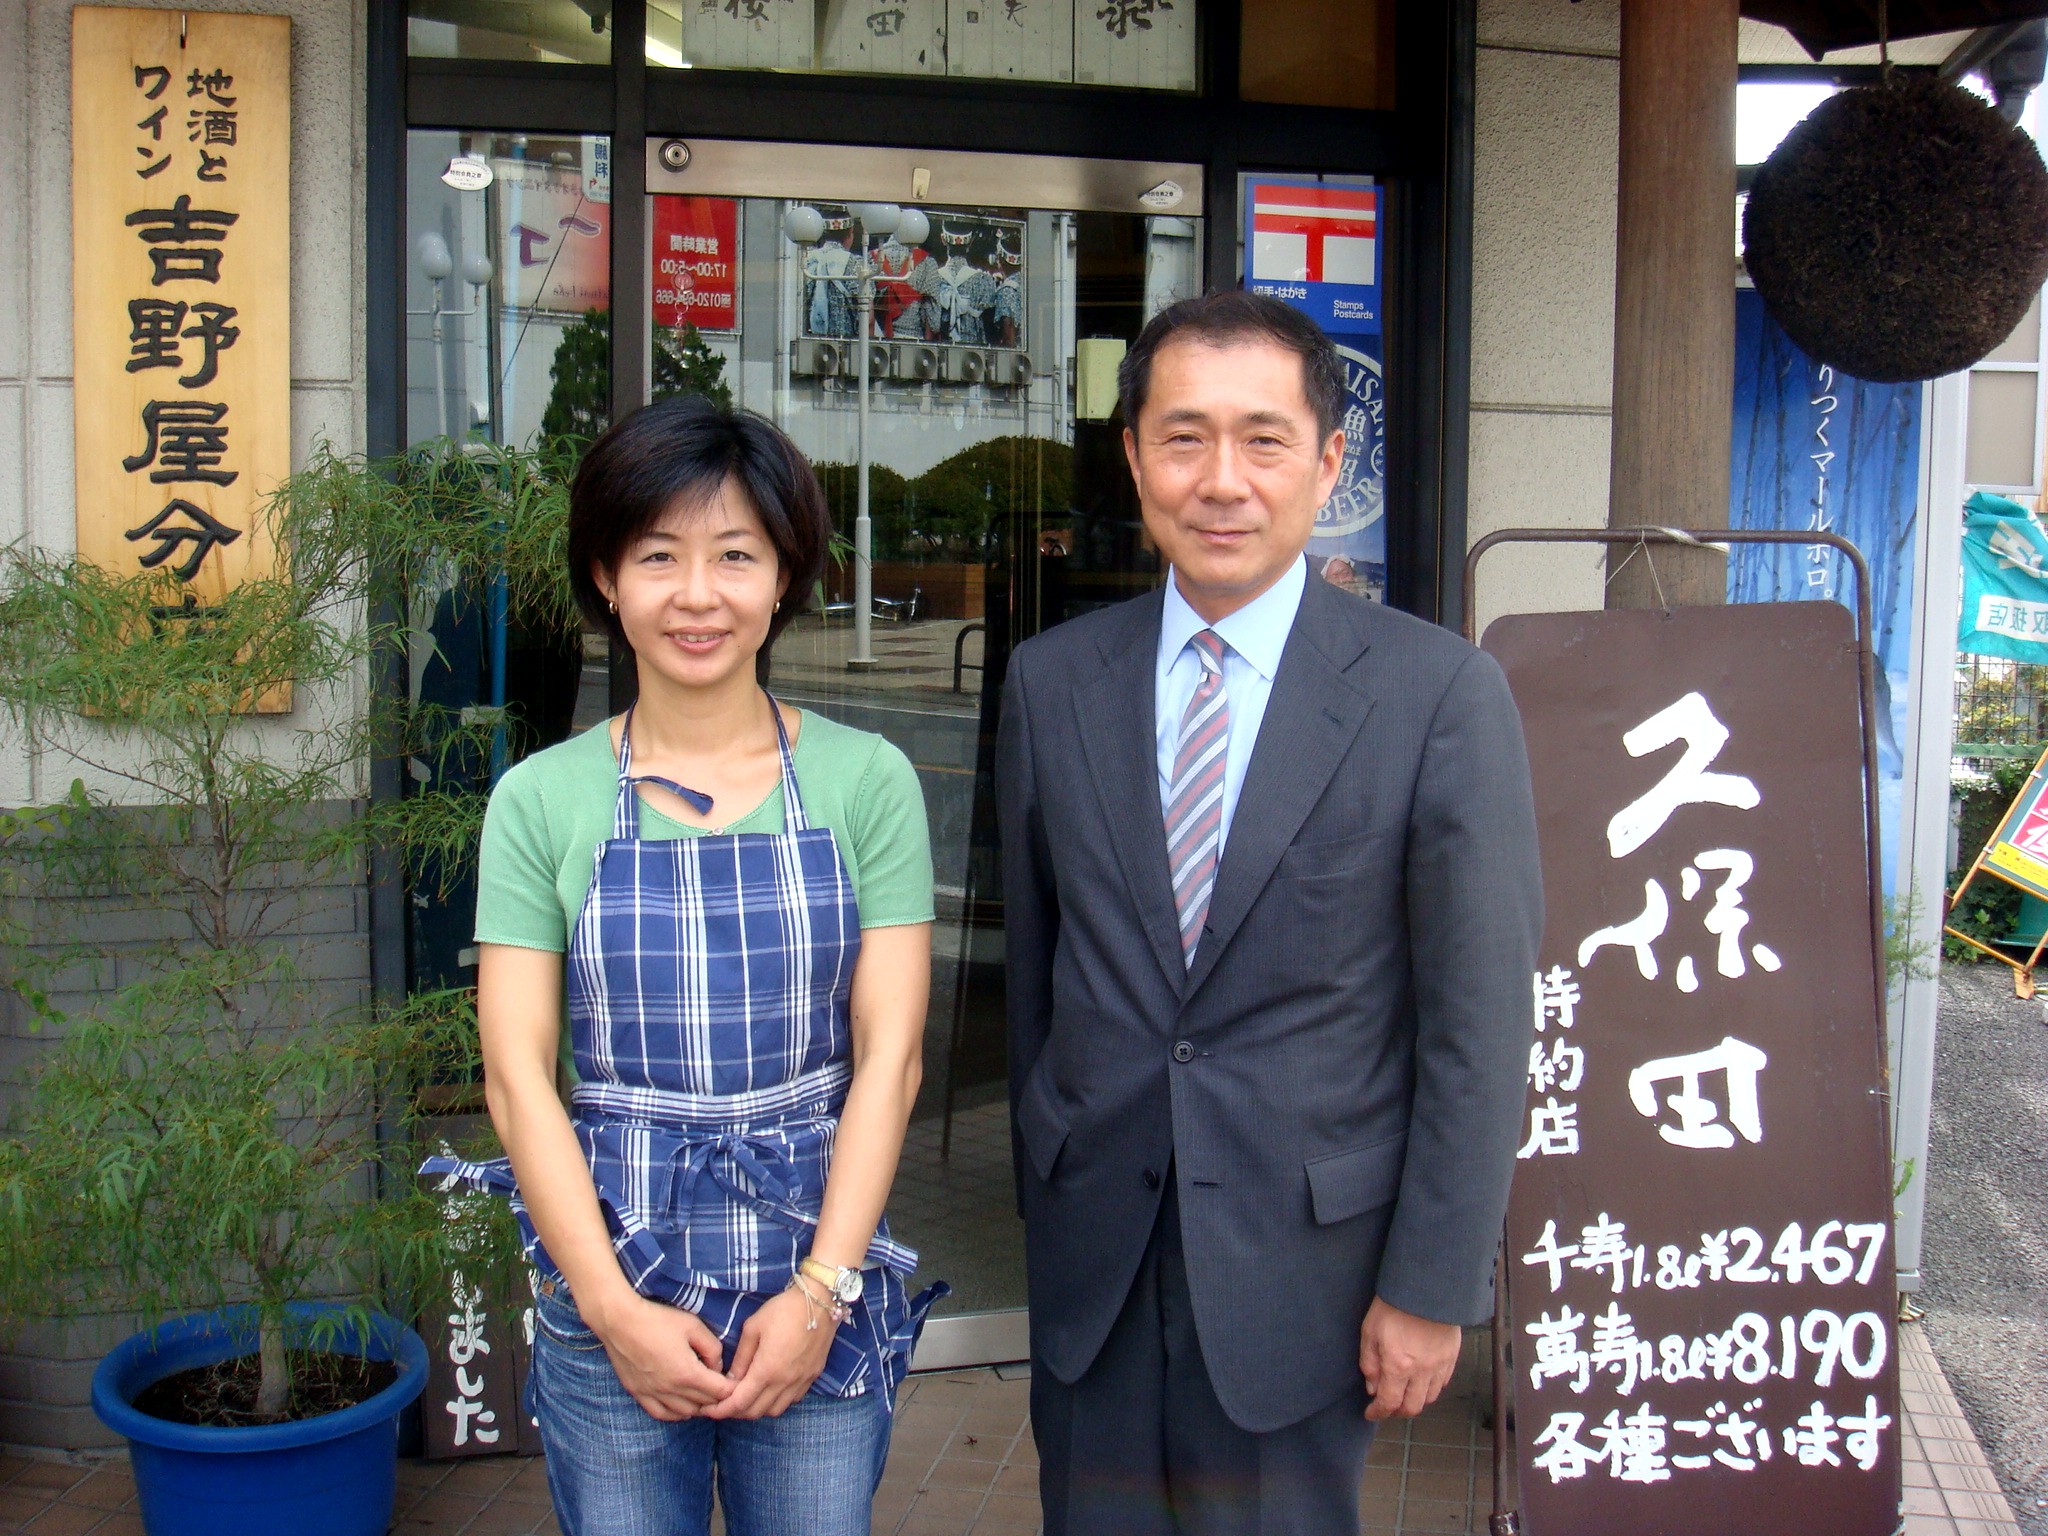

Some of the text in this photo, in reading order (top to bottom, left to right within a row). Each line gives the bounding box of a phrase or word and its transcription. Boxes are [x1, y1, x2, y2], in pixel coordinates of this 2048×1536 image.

[134, 65, 172, 181] ワイン
[187, 67, 238, 182] 地酒と
[1333, 299, 1364, 311] Stamps
[1333, 308, 1374, 320] Postcards
[124, 195, 242, 642] 吉野屋分
[1314, 477, 1382, 523] BEER
[1578, 691, 1781, 1149] 久保田
[1516, 965, 1585, 1160] 特約店
[1532, 1394, 1891, 1484] 各種ございます
